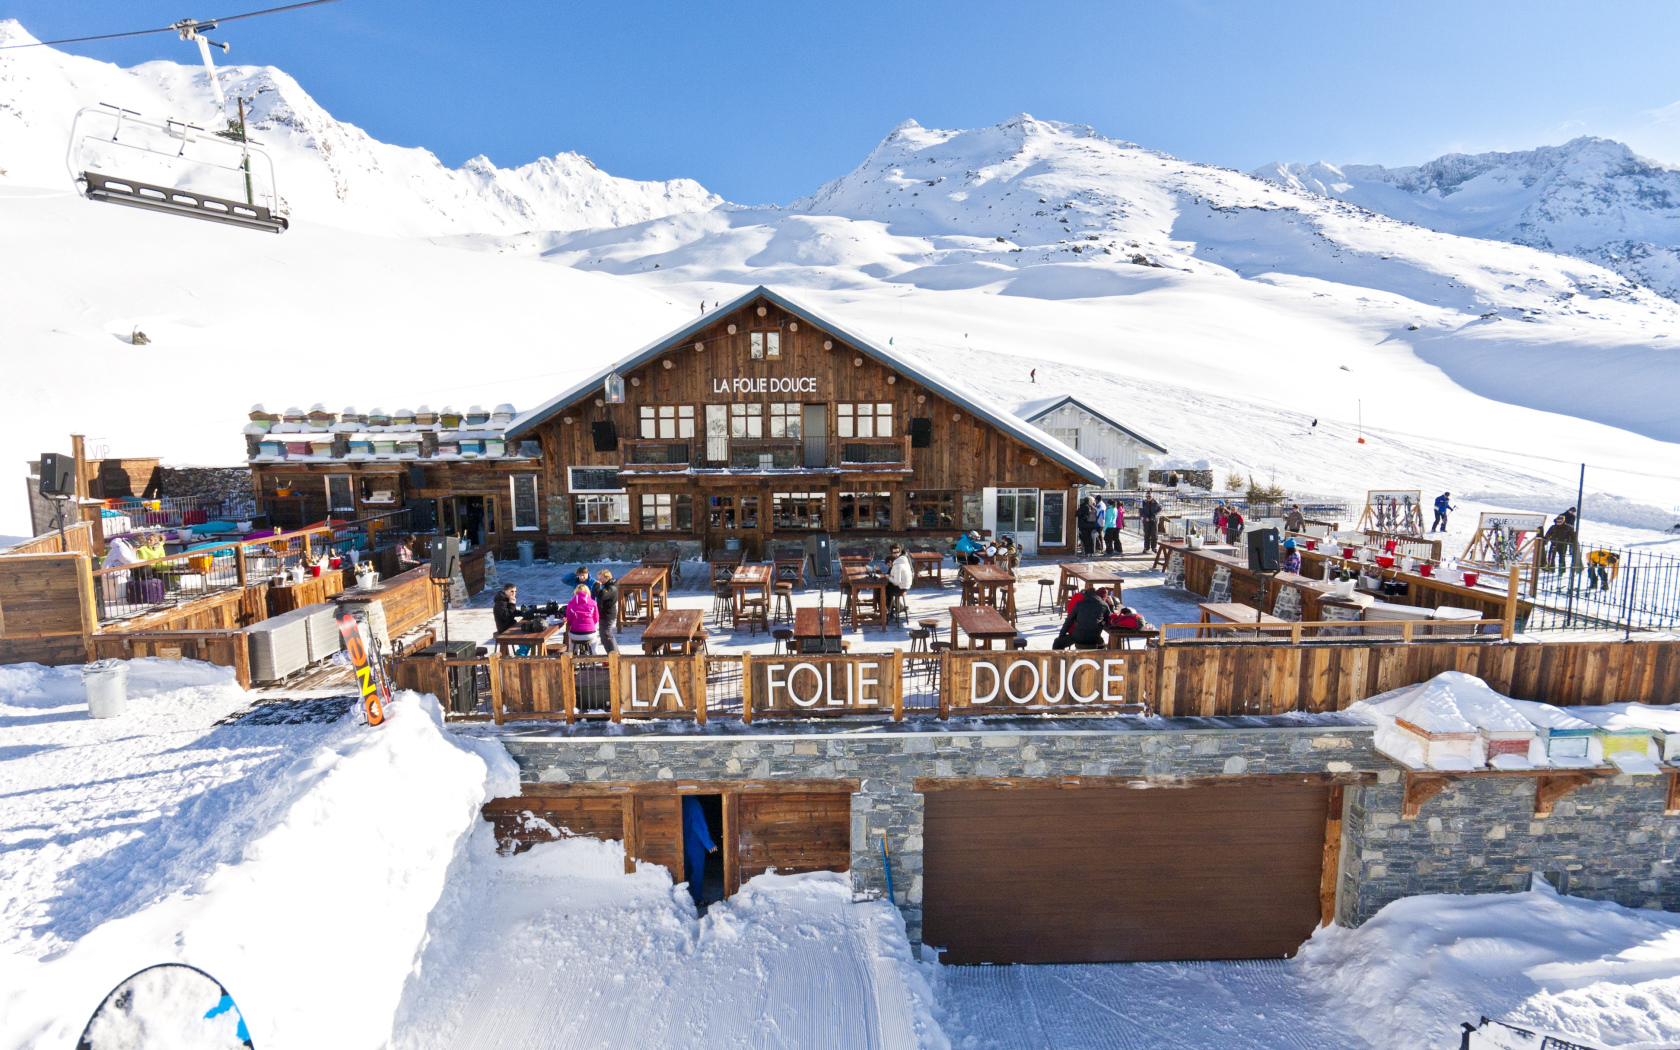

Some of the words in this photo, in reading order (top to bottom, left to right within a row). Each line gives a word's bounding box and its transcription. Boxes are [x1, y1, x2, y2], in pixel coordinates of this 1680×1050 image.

[713, 378, 730, 393] LA
[733, 378, 767, 393] FOLIE
[770, 377, 817, 393] DOUCE
[89, 444, 110, 459] VIP
[1489, 517, 1508, 525] FOLIE
[631, 663, 684, 708] LA
[767, 662, 879, 707] FOLIE
[971, 658, 1125, 704] DOUCE
